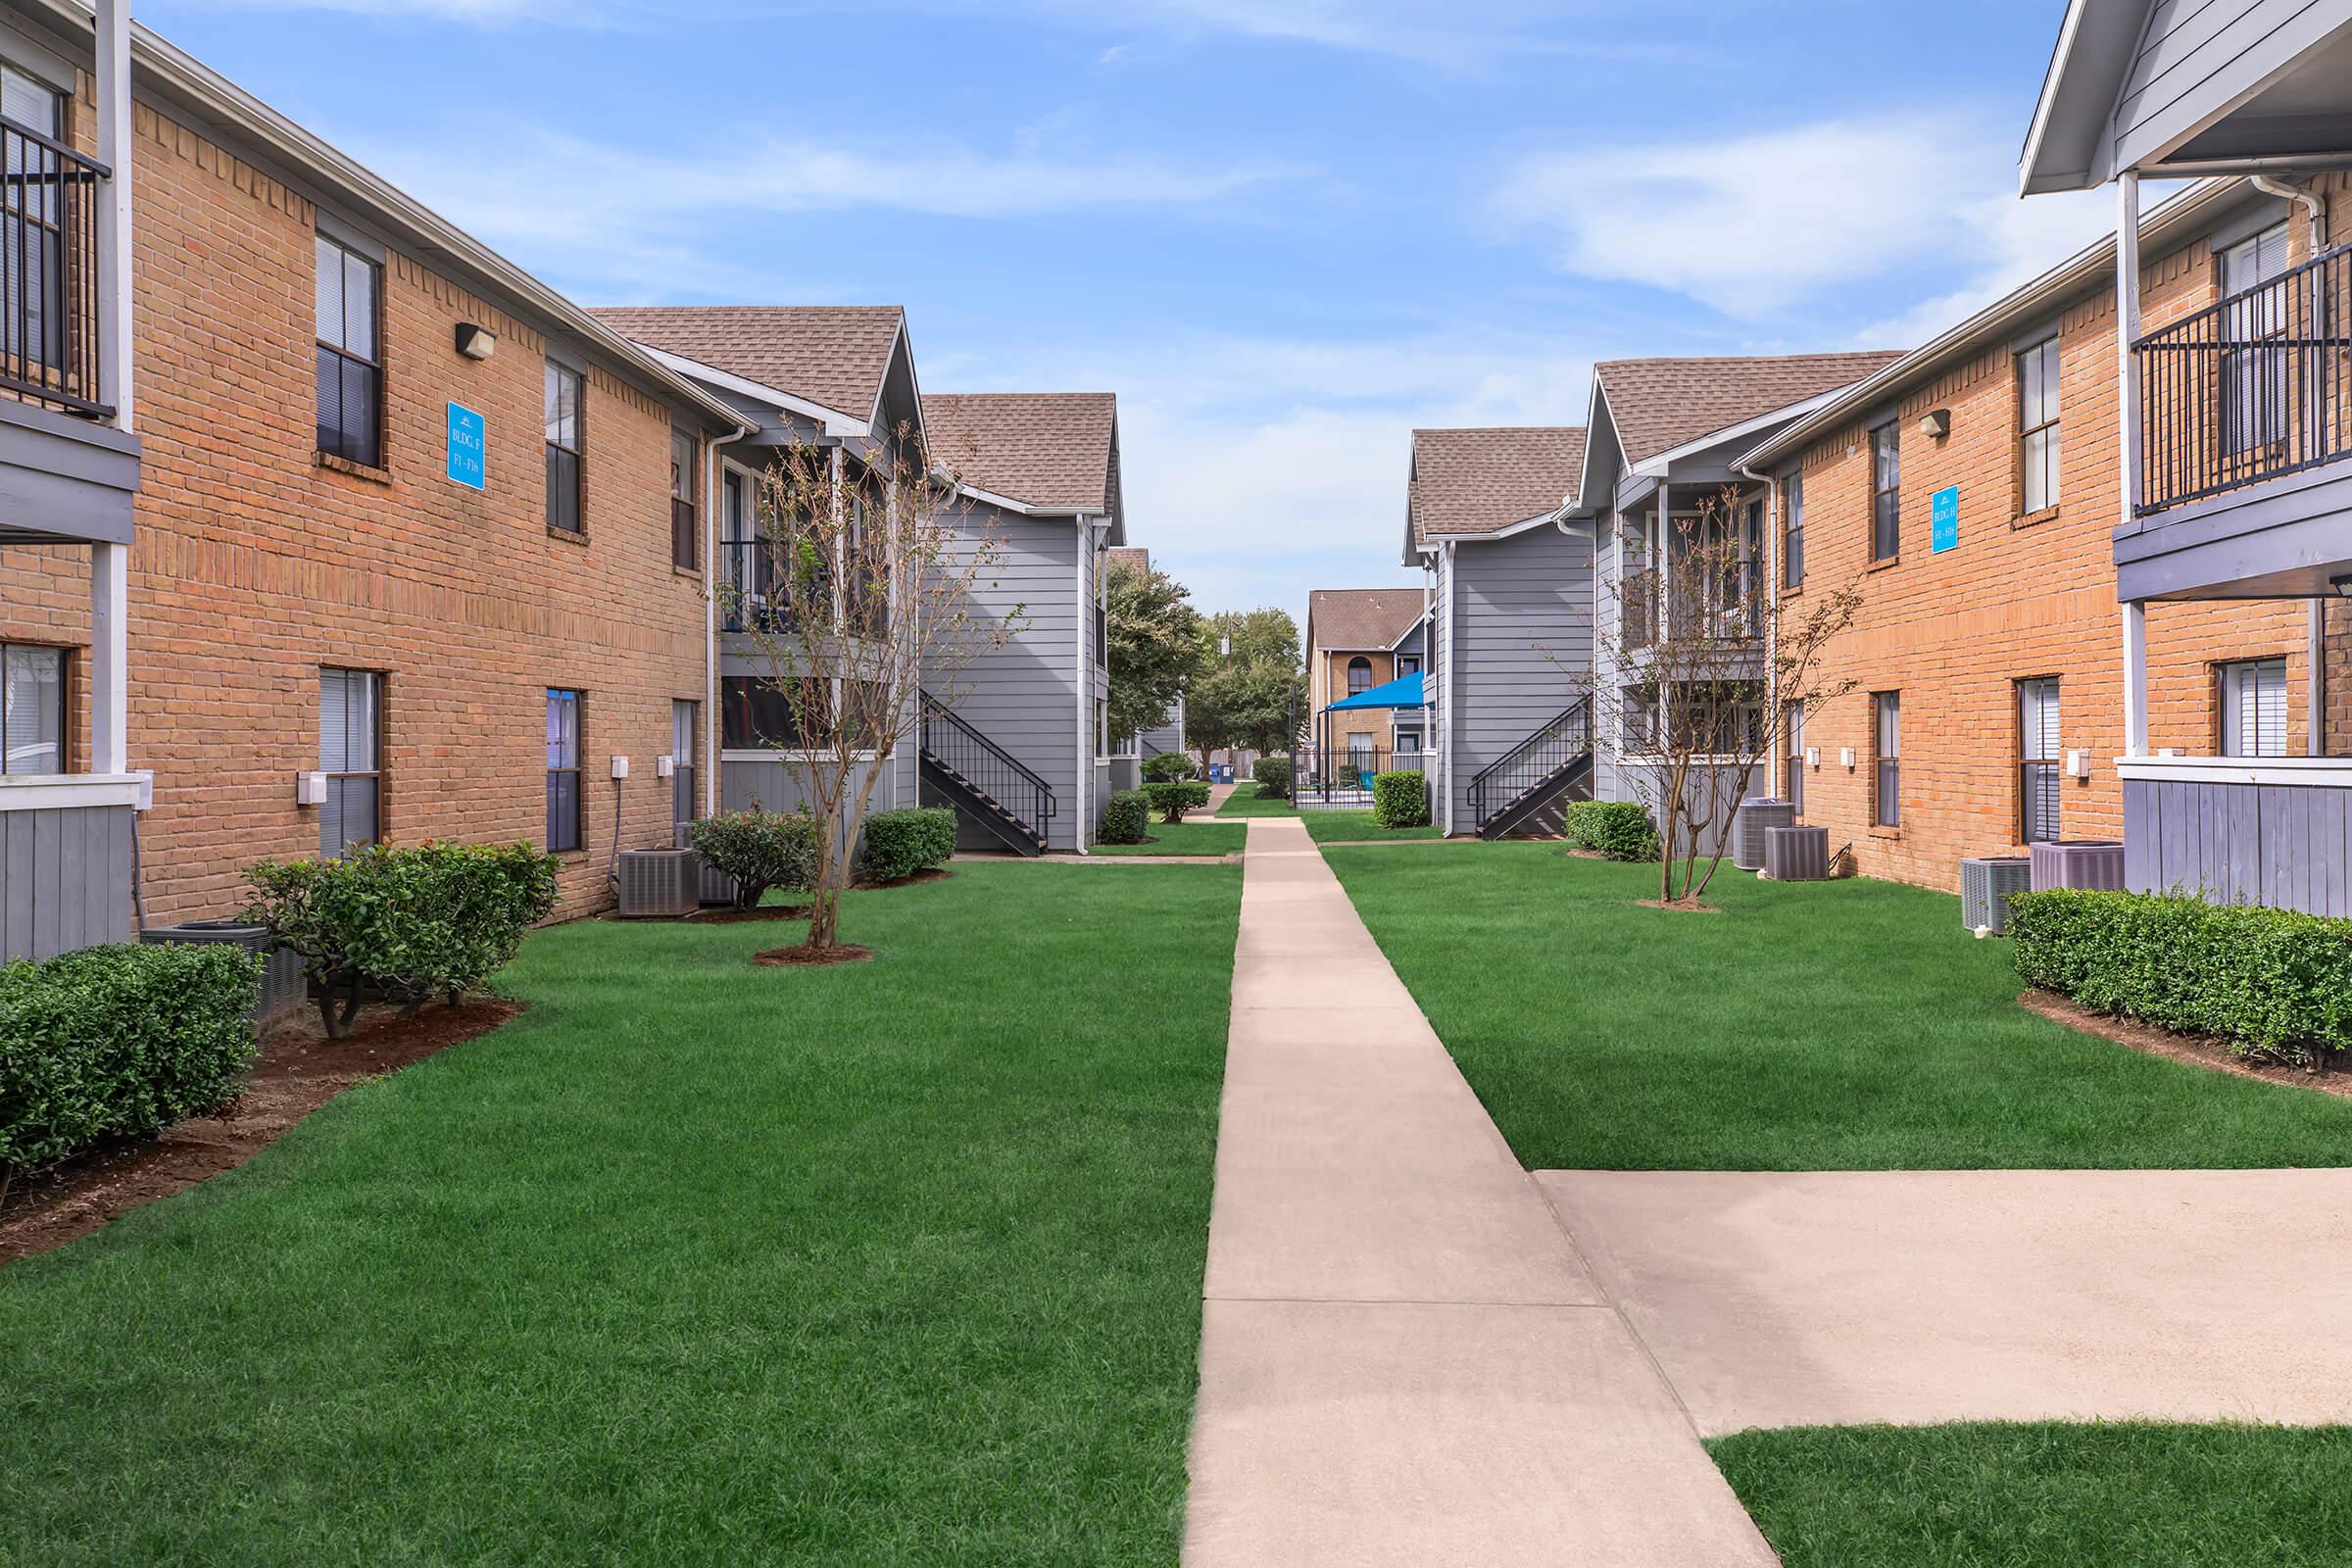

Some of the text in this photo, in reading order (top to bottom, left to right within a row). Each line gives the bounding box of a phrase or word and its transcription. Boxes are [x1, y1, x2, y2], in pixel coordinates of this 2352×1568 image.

[452, 428, 481, 451] BLDG. F
[454, 453, 462, 467] F1
[466, 458, 479, 472] F16
